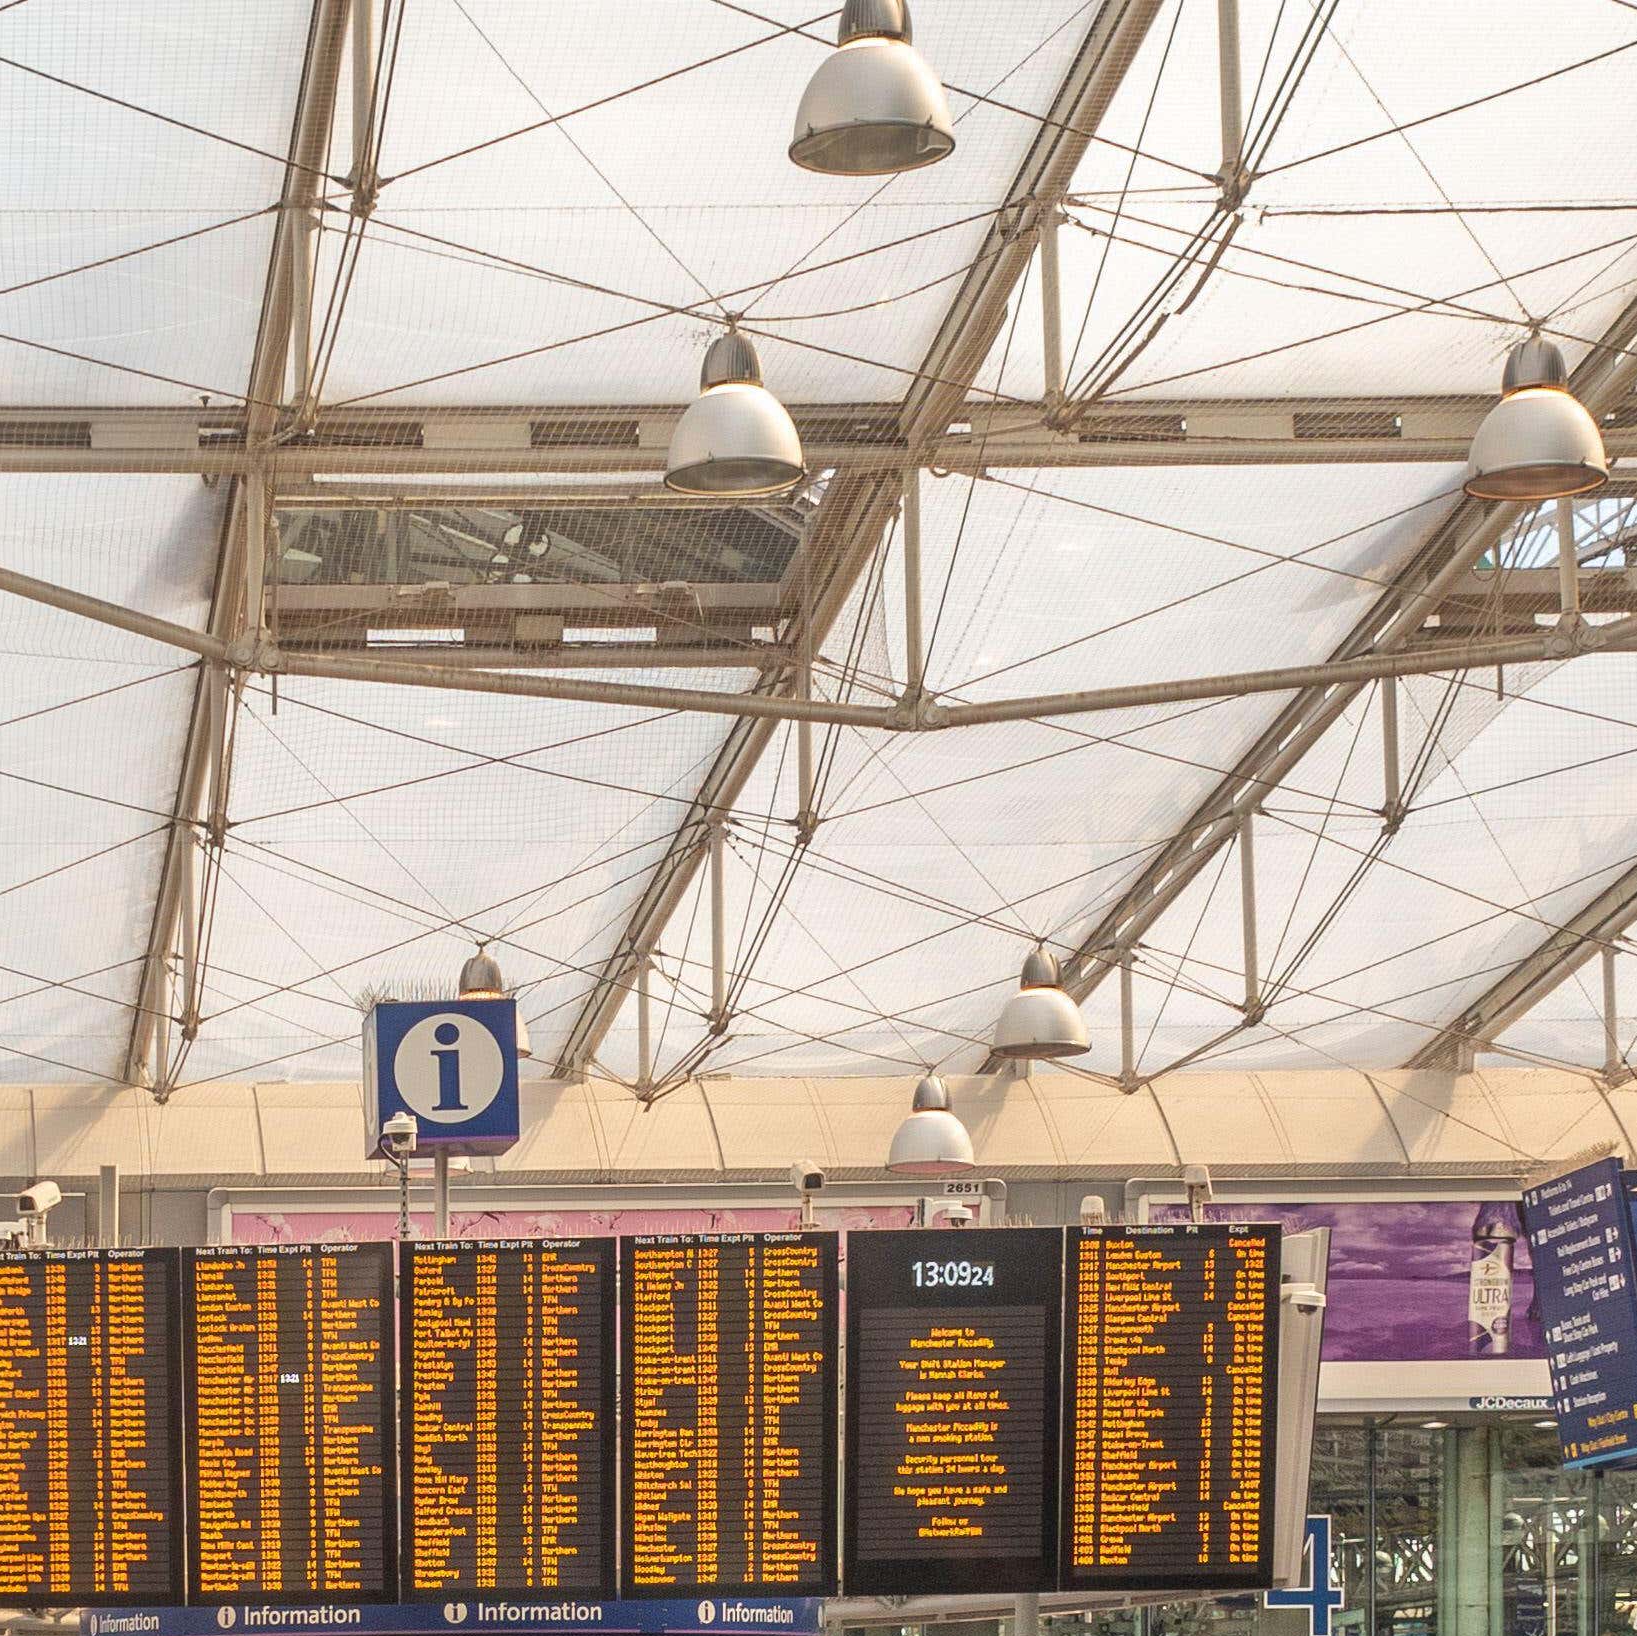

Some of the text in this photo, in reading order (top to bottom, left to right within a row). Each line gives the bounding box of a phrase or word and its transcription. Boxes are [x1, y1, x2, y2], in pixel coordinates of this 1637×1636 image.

[947, 1183, 979, 1193] 2651
[635, 1236, 656, 1245] Next
[657, 1236, 678, 1245] Train
[680, 1235, 694, 1244] To:
[699, 1235, 720, 1244] Time
[722, 1234, 740, 1245] Expt
[764, 1232, 803, 1244] Operator
[1126, 1226, 1174, 1235] Destination
[1229, 1226, 1249, 1235] Expt
[1474, 1288, 1509, 1304] ULTRA
[1476, 1397, 1548, 1409] JCDecaux
[244, 1605, 361, 1626] Information
[478, 1602, 602, 1622] Information
[722, 1602, 794, 1625] Information
[99, 1611, 160, 1634] Information
